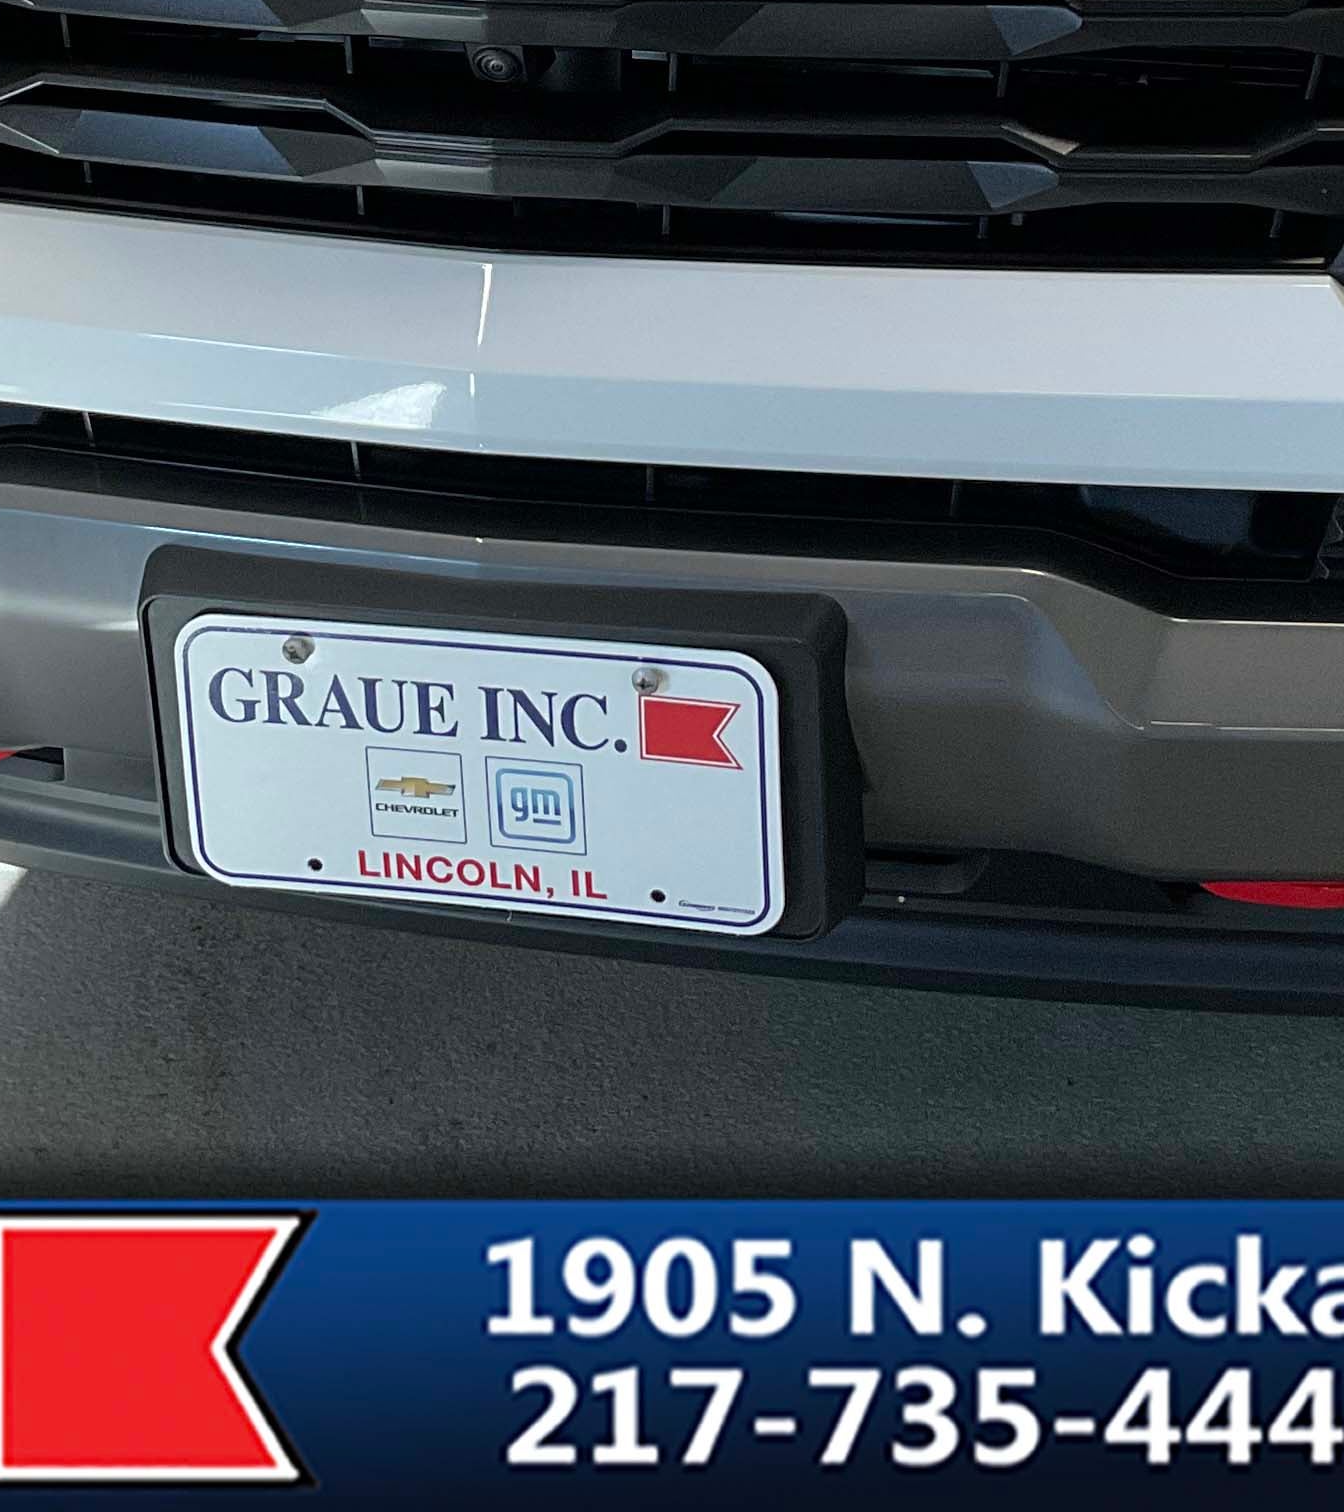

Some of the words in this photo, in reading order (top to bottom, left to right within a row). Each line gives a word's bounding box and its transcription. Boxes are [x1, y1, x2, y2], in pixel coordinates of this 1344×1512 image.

[208, 666, 459, 737] GRAUE
[477, 685, 628, 754] INC.
[374, 801, 460, 818] CHEVROLET
[510, 786, 562, 826] gm
[357, 849, 555, 899] LINCOLN,
[571, 869, 608, 900] IL
